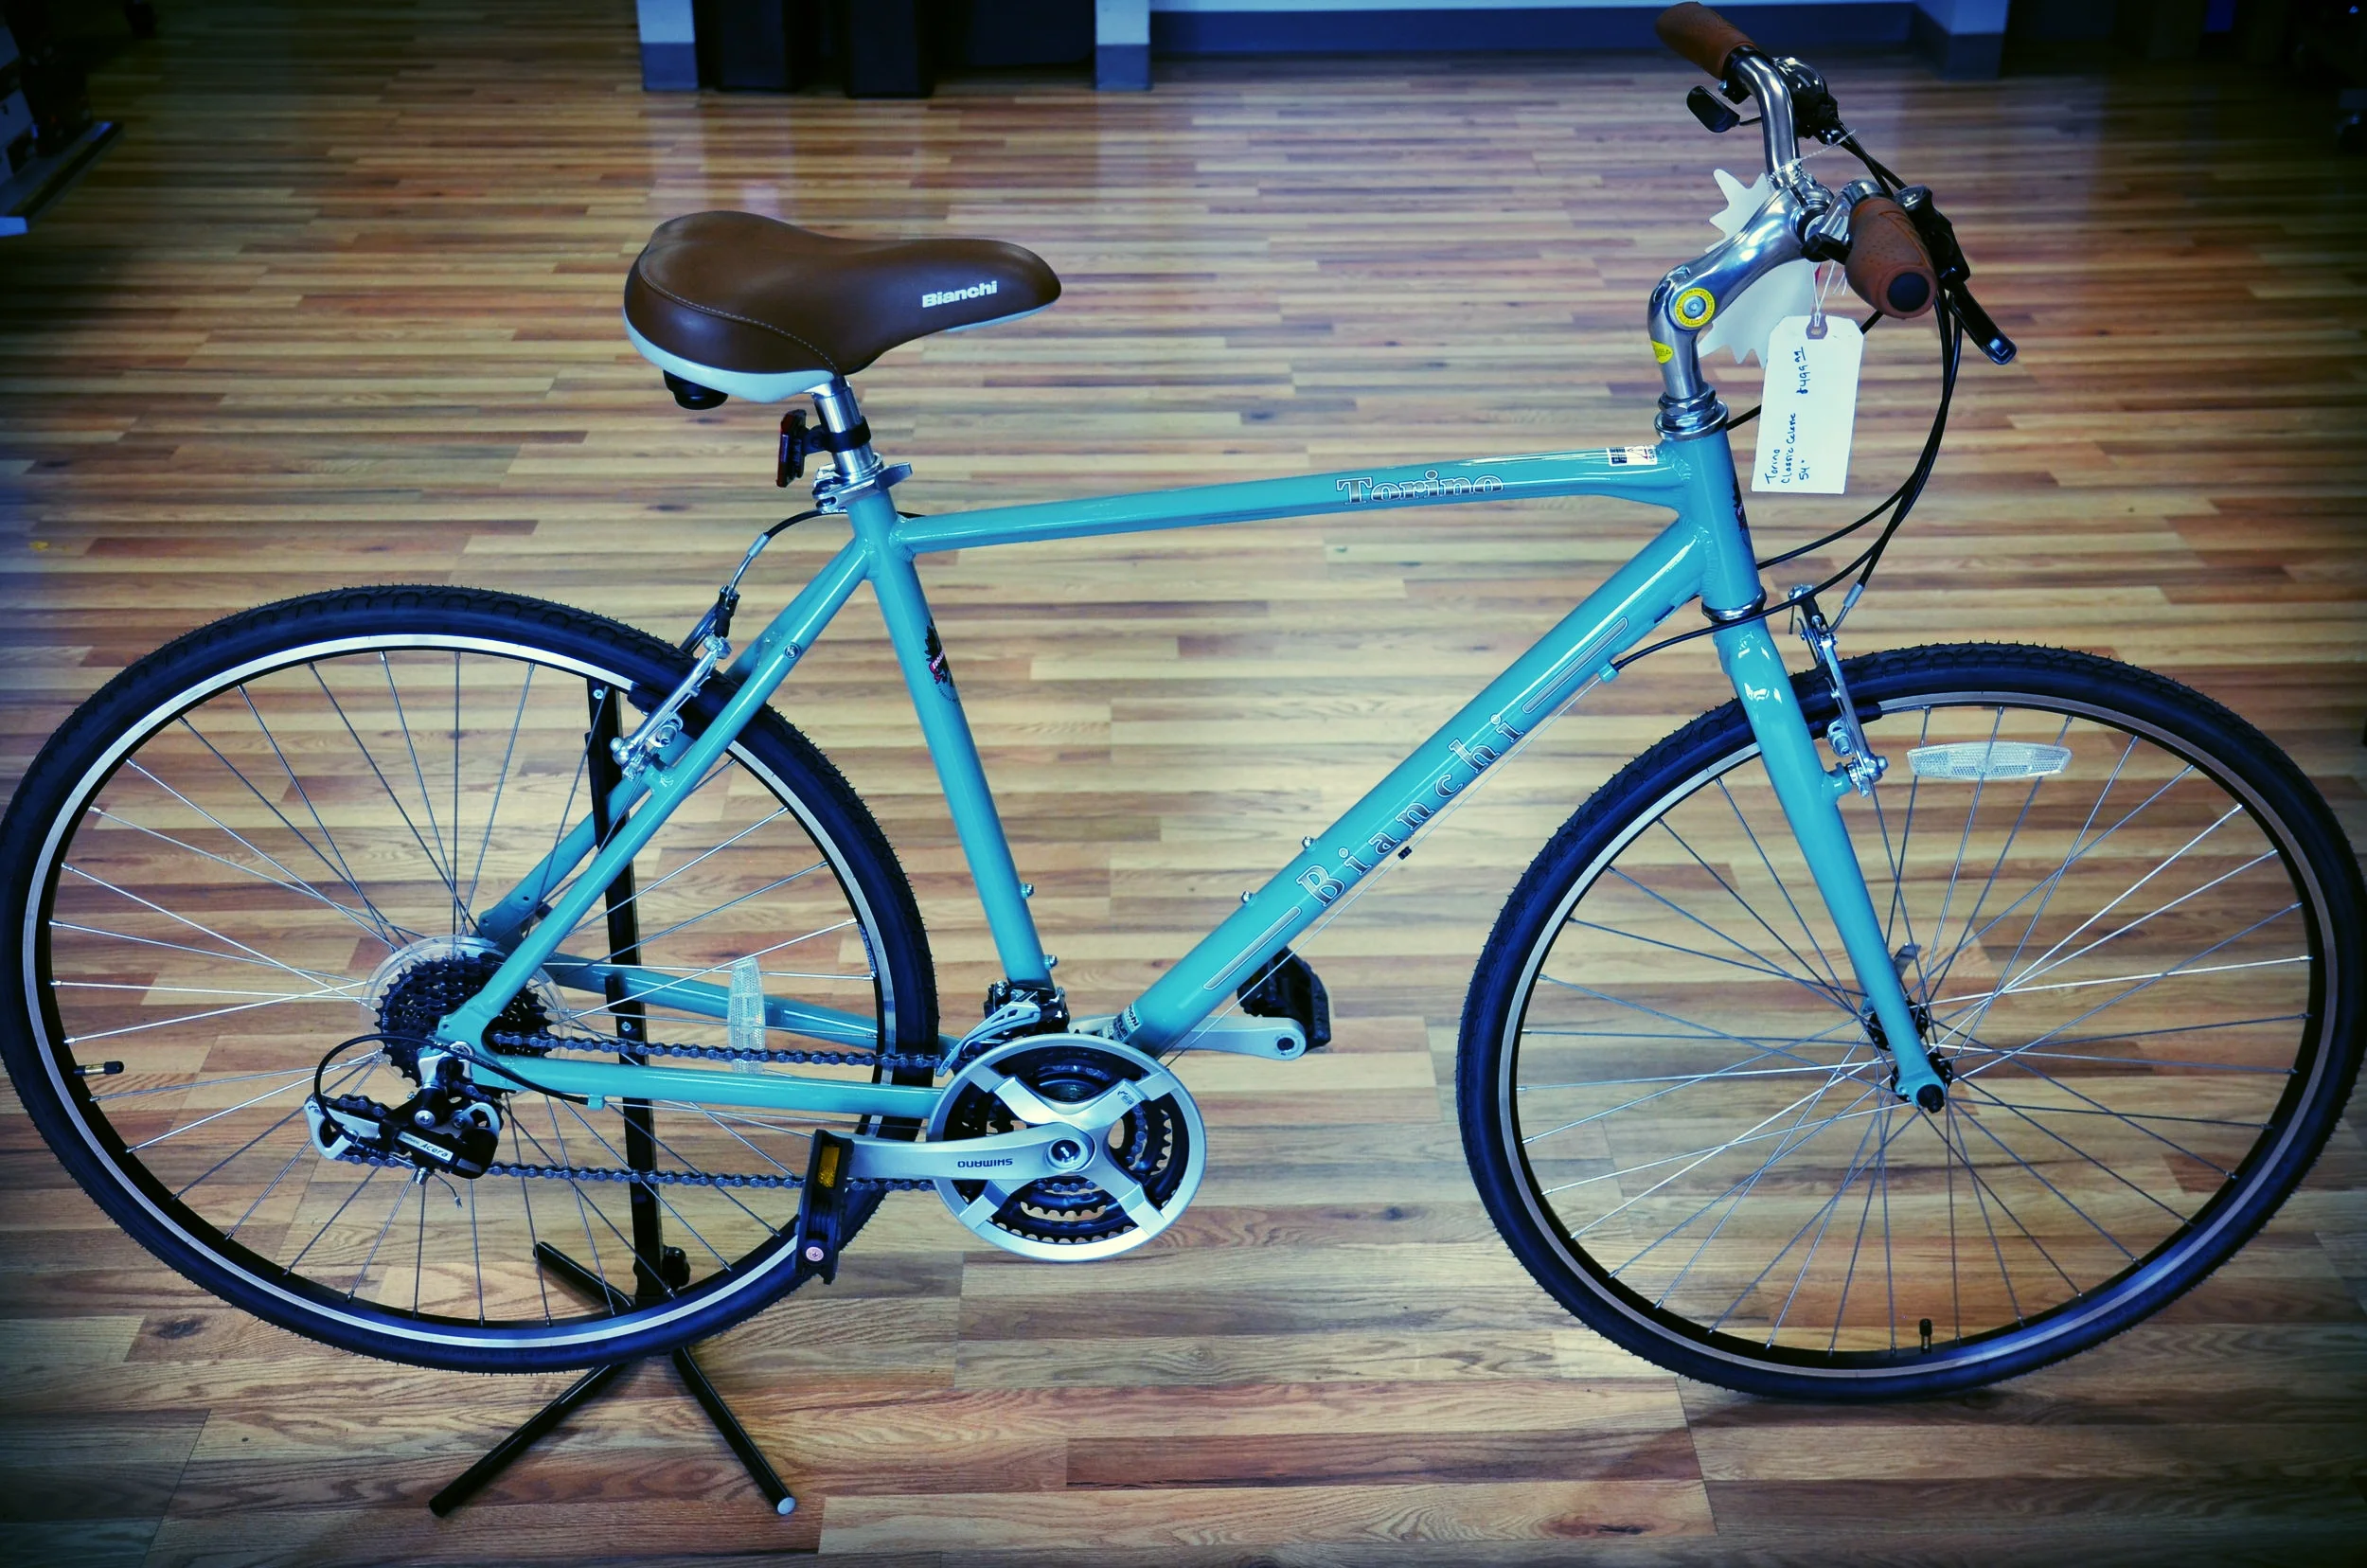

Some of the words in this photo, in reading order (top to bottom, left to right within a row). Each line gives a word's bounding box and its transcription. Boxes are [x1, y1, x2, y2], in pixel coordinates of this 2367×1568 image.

[922, 280, 998, 308] Bianchi
[1764, 449, 1781, 485] Torino
[1781, 447, 1795, 484] Classic
[1336, 470, 1504, 506] Torino
[1296, 714, 1525, 907] Bianchi
[419, 1142, 450, 1158] Acera
[957, 1157, 1014, 1168] SHIMANO
